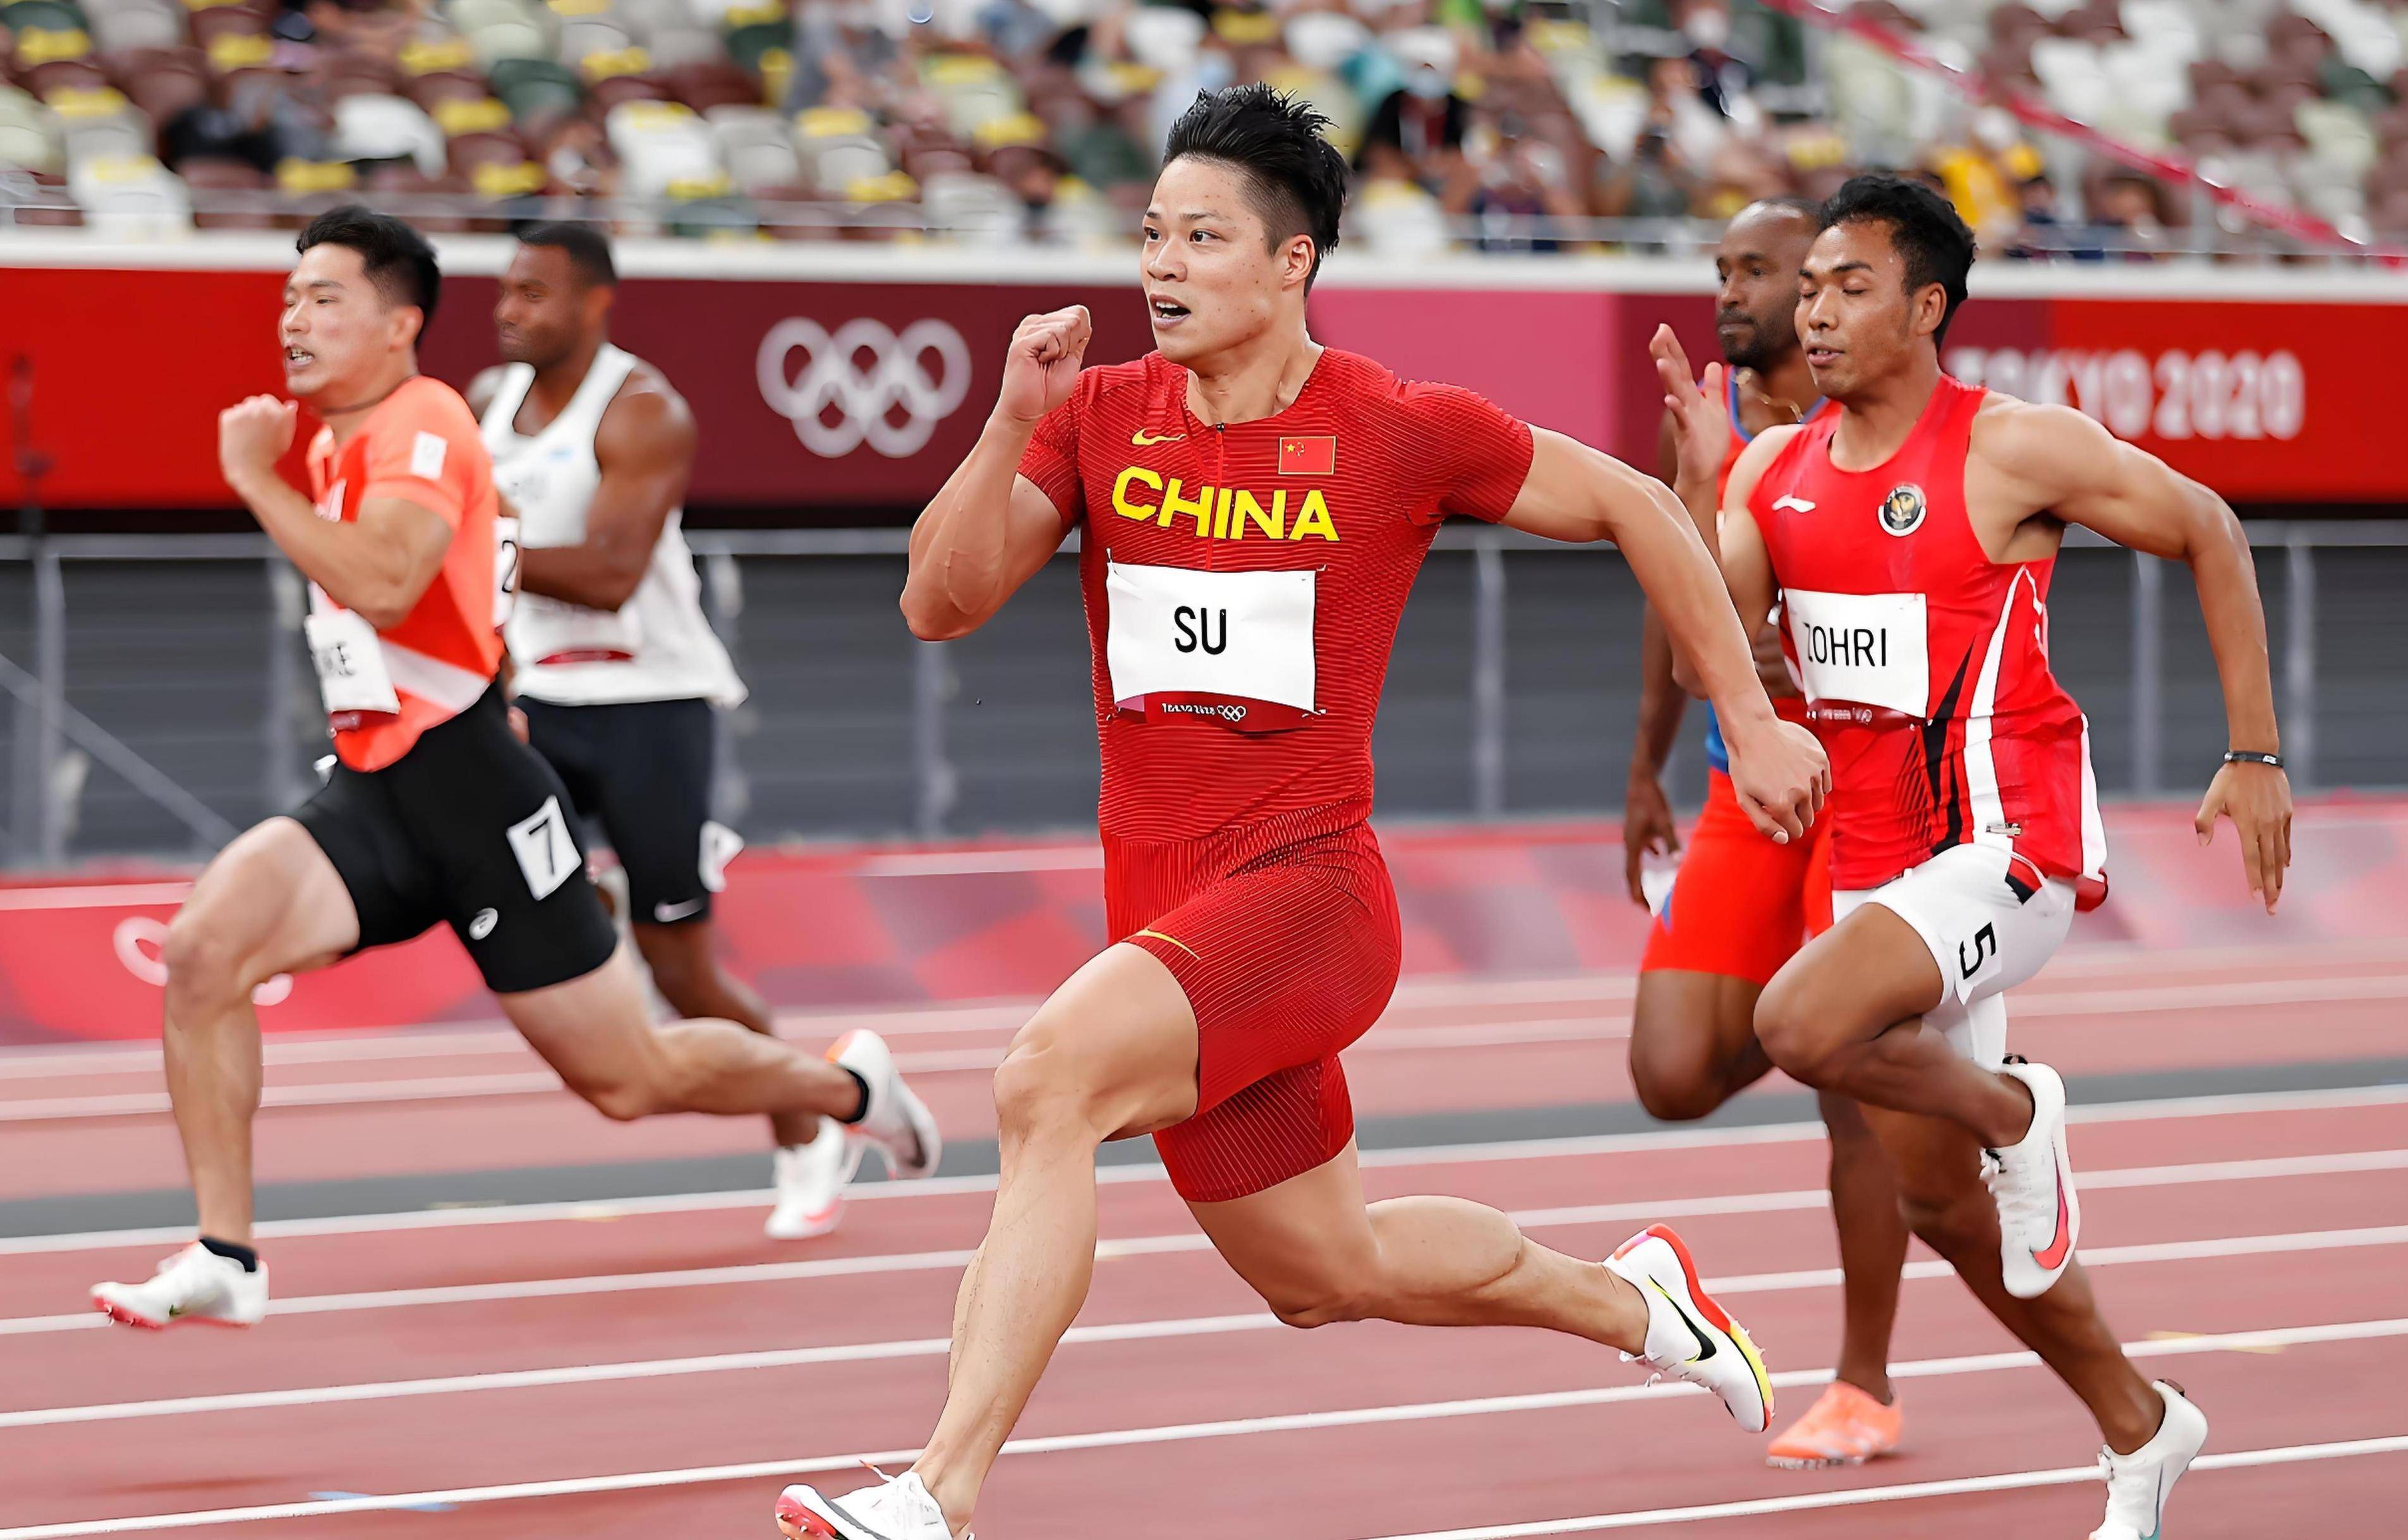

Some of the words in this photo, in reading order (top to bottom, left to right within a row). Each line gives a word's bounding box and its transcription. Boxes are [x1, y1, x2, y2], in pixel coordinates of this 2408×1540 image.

[2153, 348, 2305, 440] 2020
[1111, 465, 1341, 542] CHINA
[1173, 605, 1228, 655] SU
[528, 816, 555, 876] 7
[1959, 921, 1997, 980] 5
